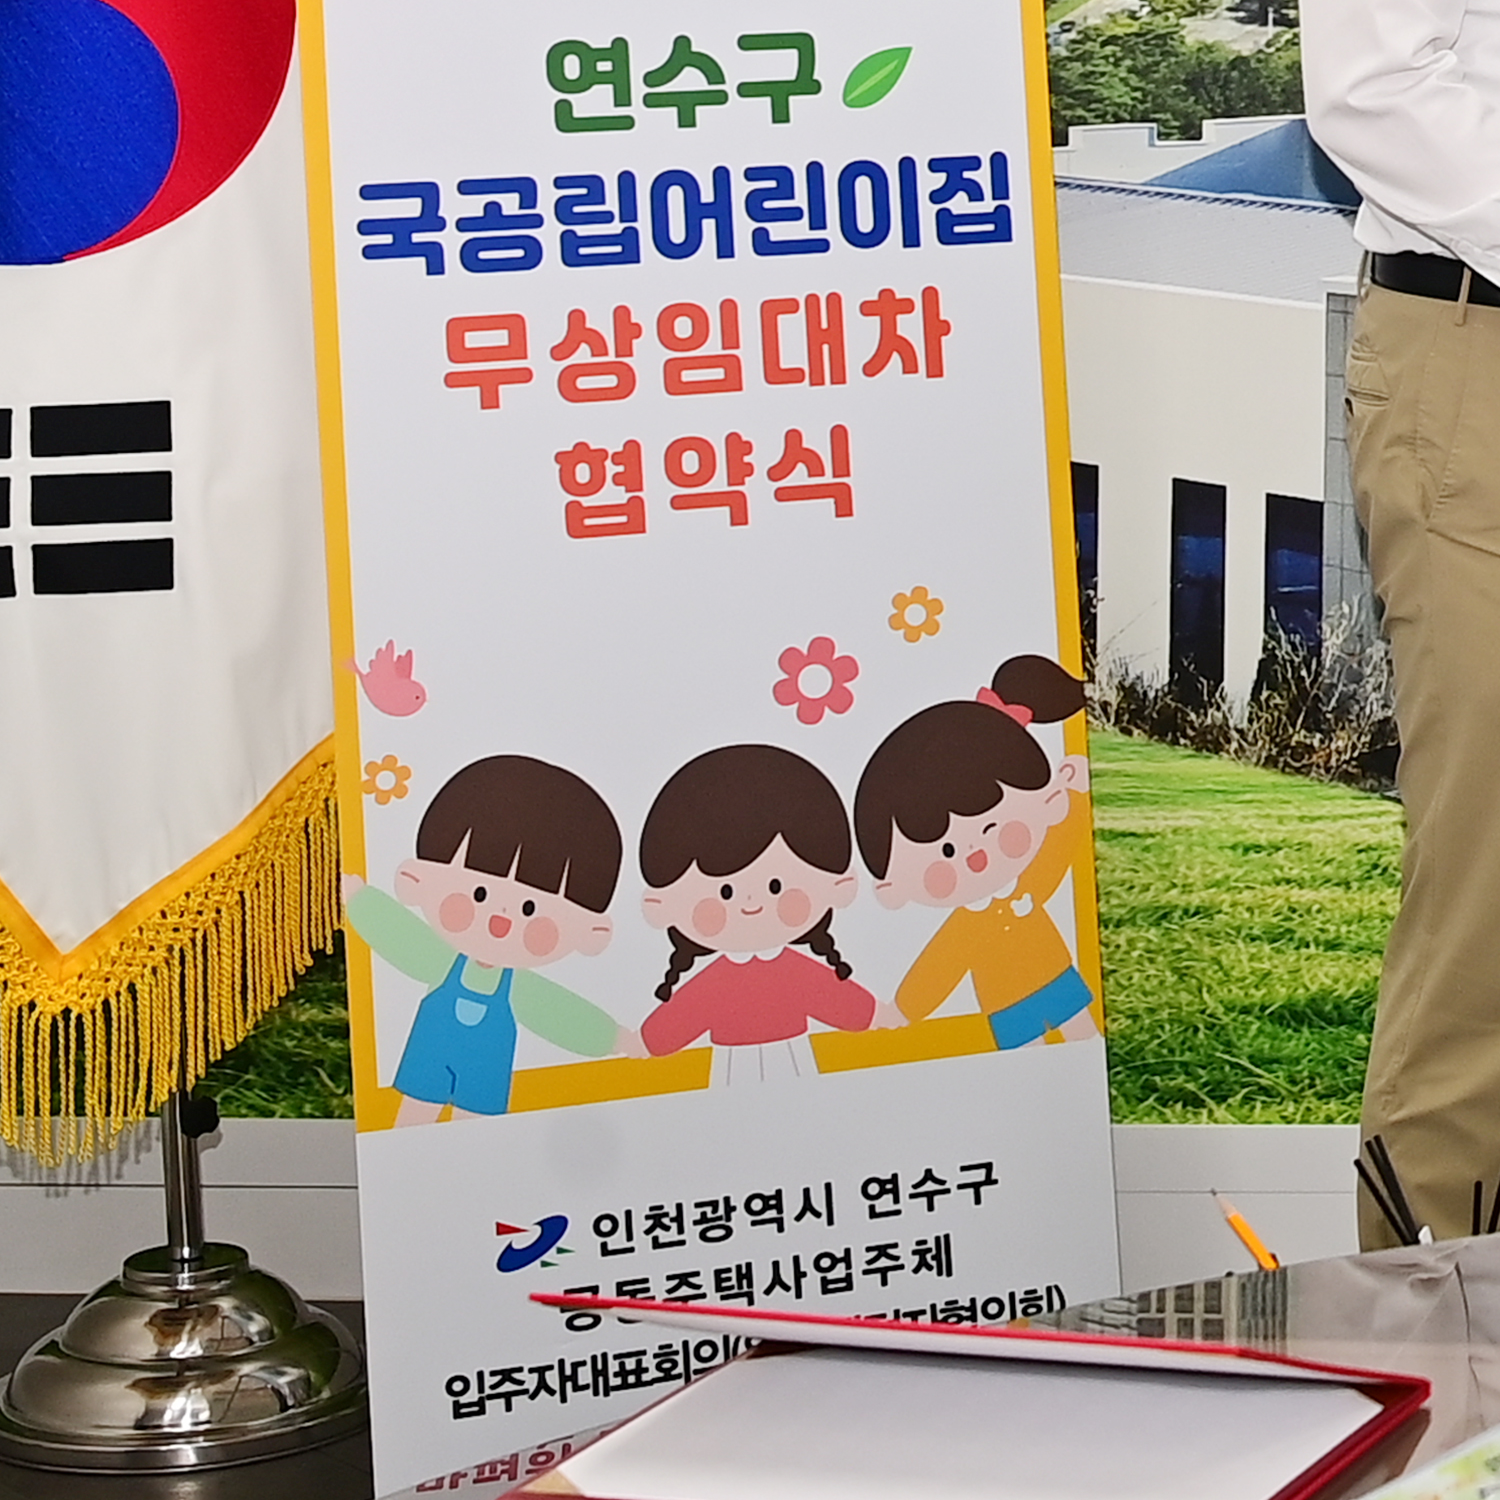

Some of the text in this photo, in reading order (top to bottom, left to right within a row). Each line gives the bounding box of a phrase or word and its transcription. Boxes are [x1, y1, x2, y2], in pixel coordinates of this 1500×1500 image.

[546, 31, 822, 133] 연수구
[356, 151, 1013, 276] 국공립어린이집
[444, 286, 952, 410] 무상임대차
[554, 424, 855, 540] 협약식
[592, 1161, 1000, 1258] 인천광역시 연수구
